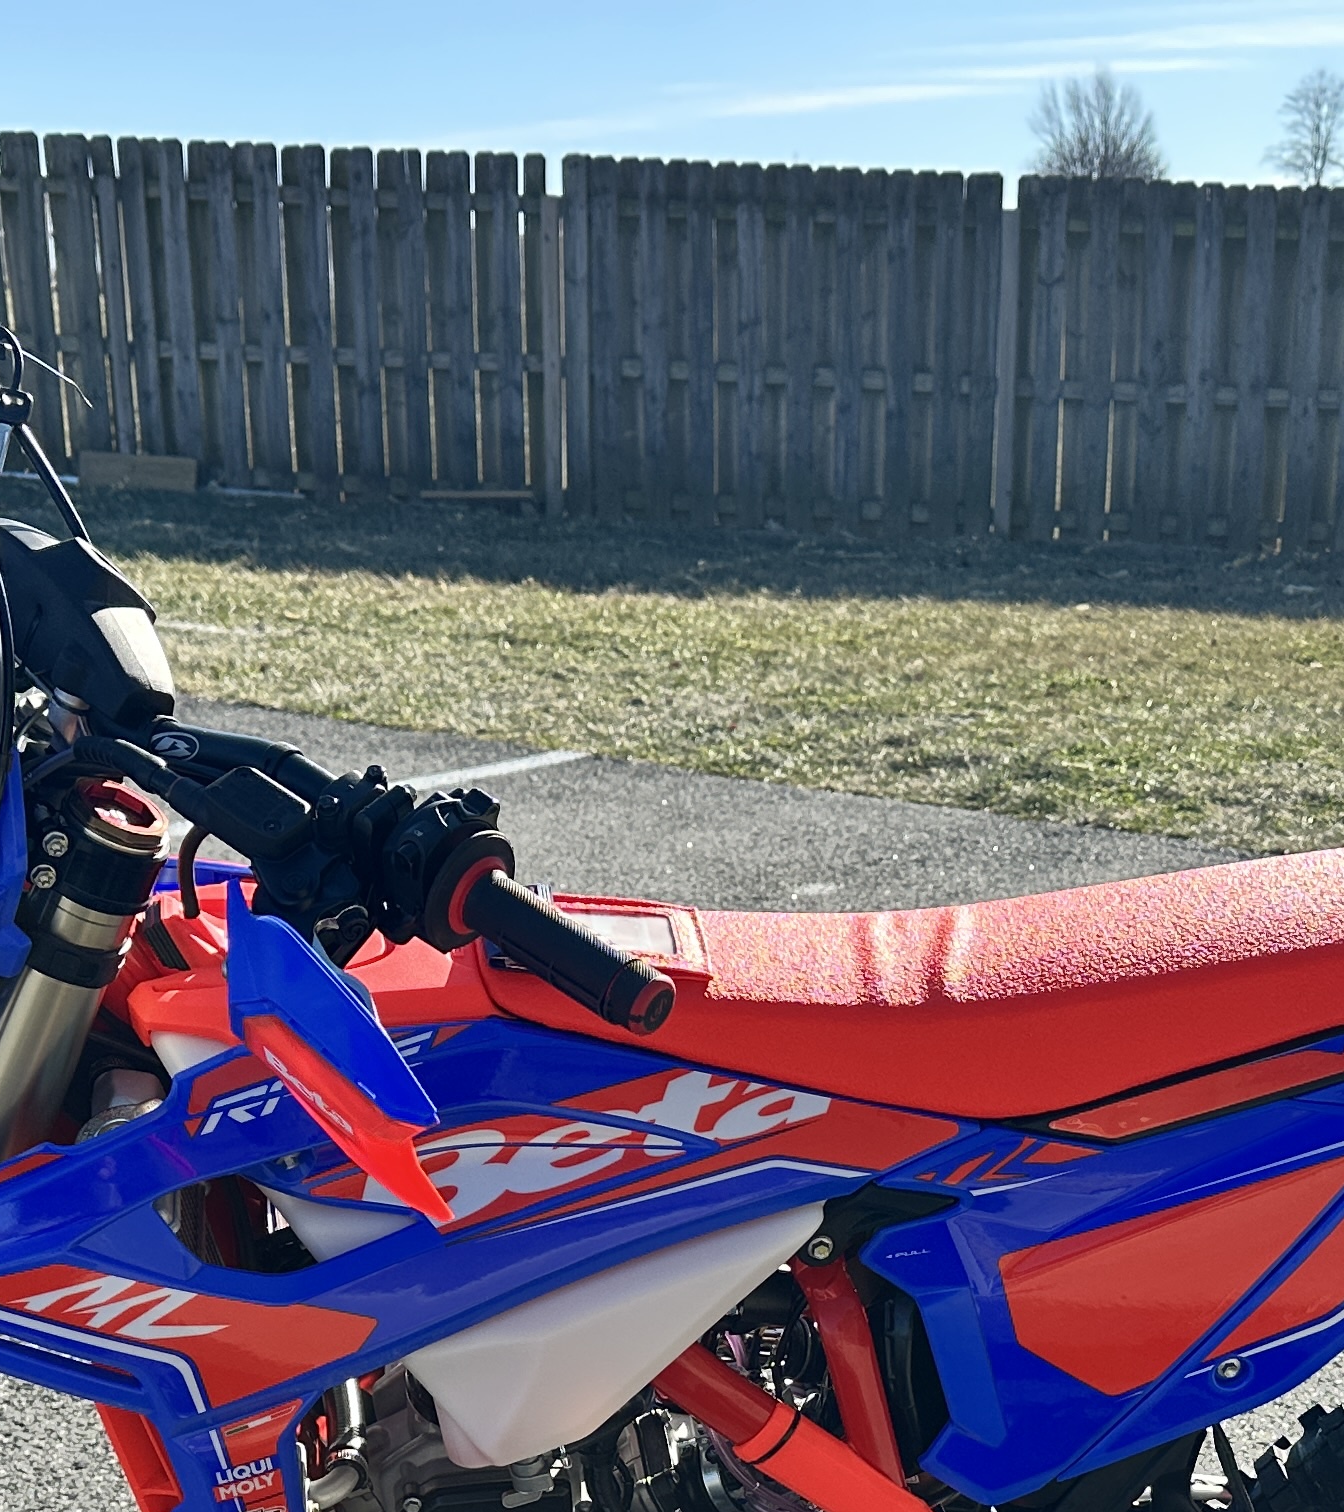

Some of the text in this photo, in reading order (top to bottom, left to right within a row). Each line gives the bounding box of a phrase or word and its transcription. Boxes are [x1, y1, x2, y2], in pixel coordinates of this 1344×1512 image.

[263, 1046, 354, 1135] Beta
[362, 1070, 833, 1229] Beta
[215, 1457, 273, 1485] LIQUI
[218, 1471, 274, 1500] MOLY
